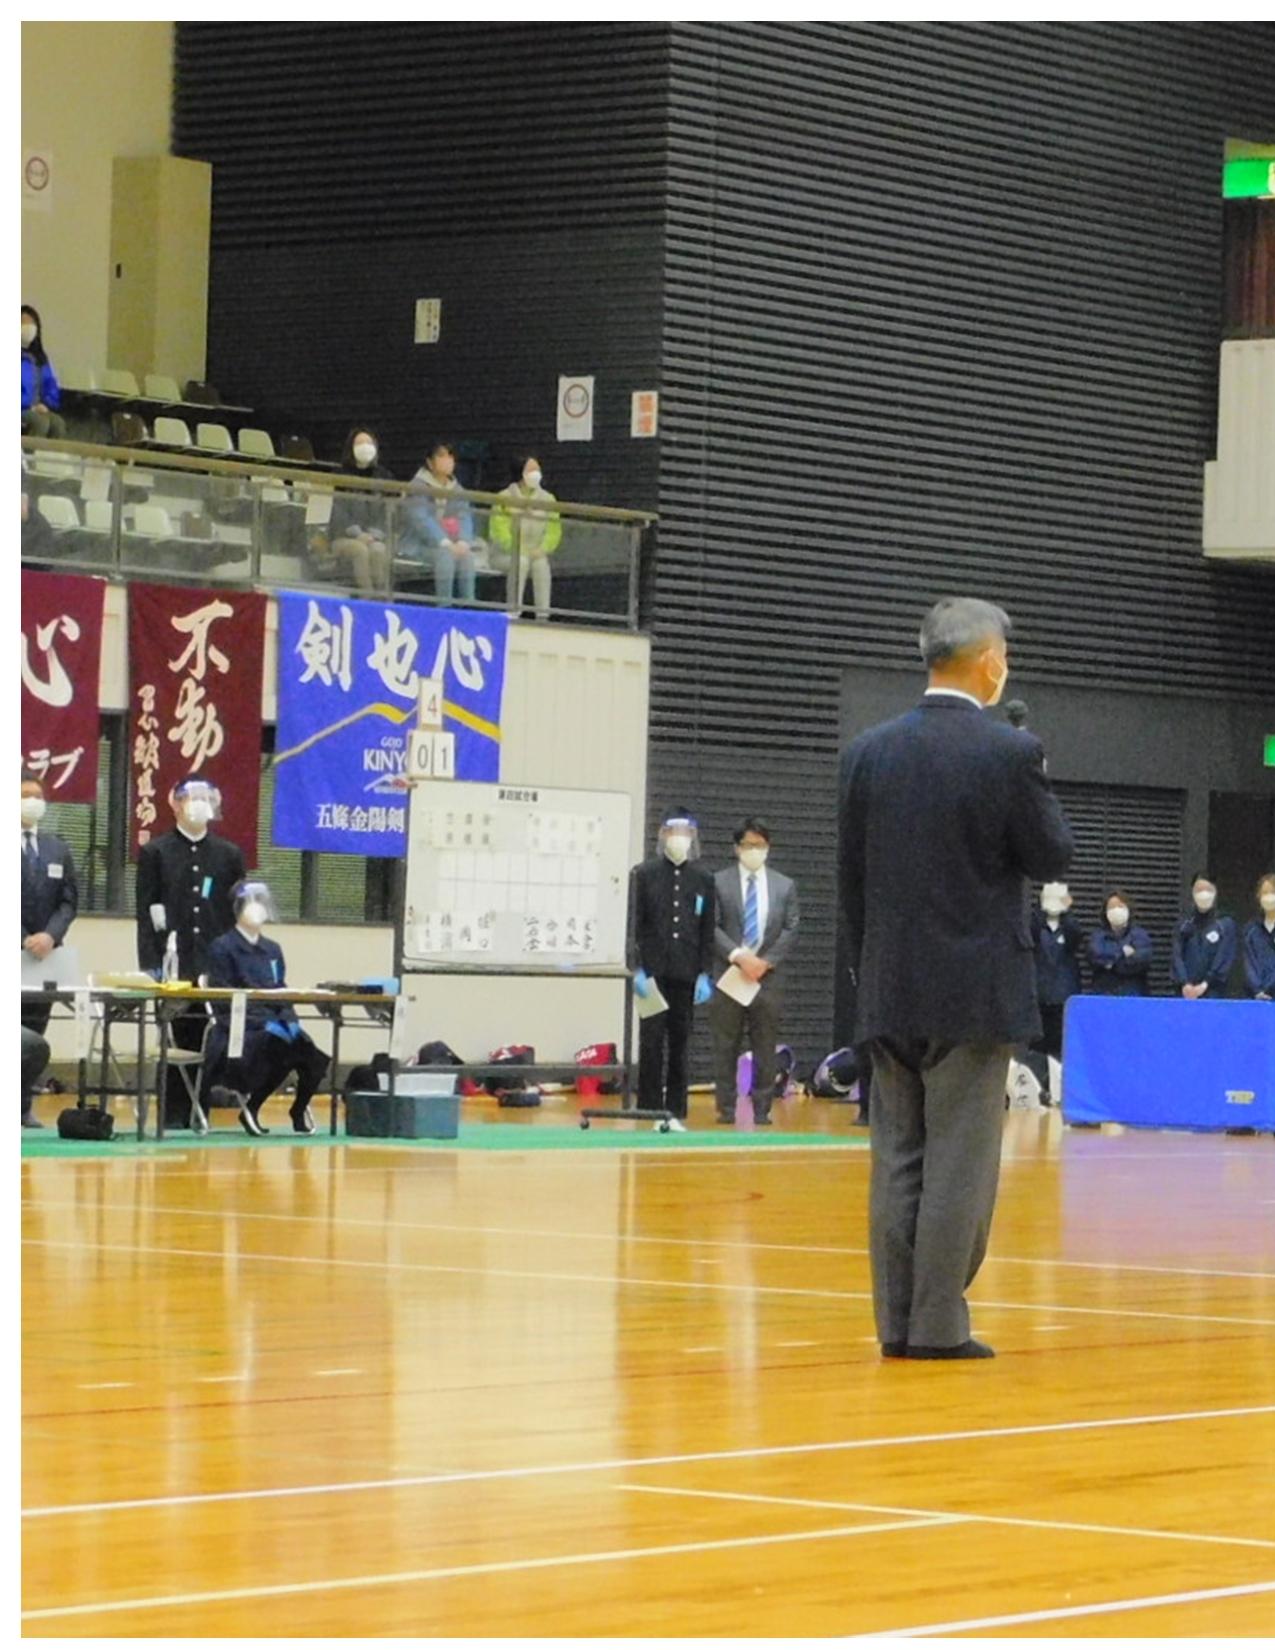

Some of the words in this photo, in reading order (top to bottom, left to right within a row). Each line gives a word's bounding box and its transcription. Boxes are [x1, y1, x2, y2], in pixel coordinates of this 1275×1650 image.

[427, 694, 438, 716] 4
[21, 746, 84, 789] ラブ
[363, 748, 409, 771] KINY
